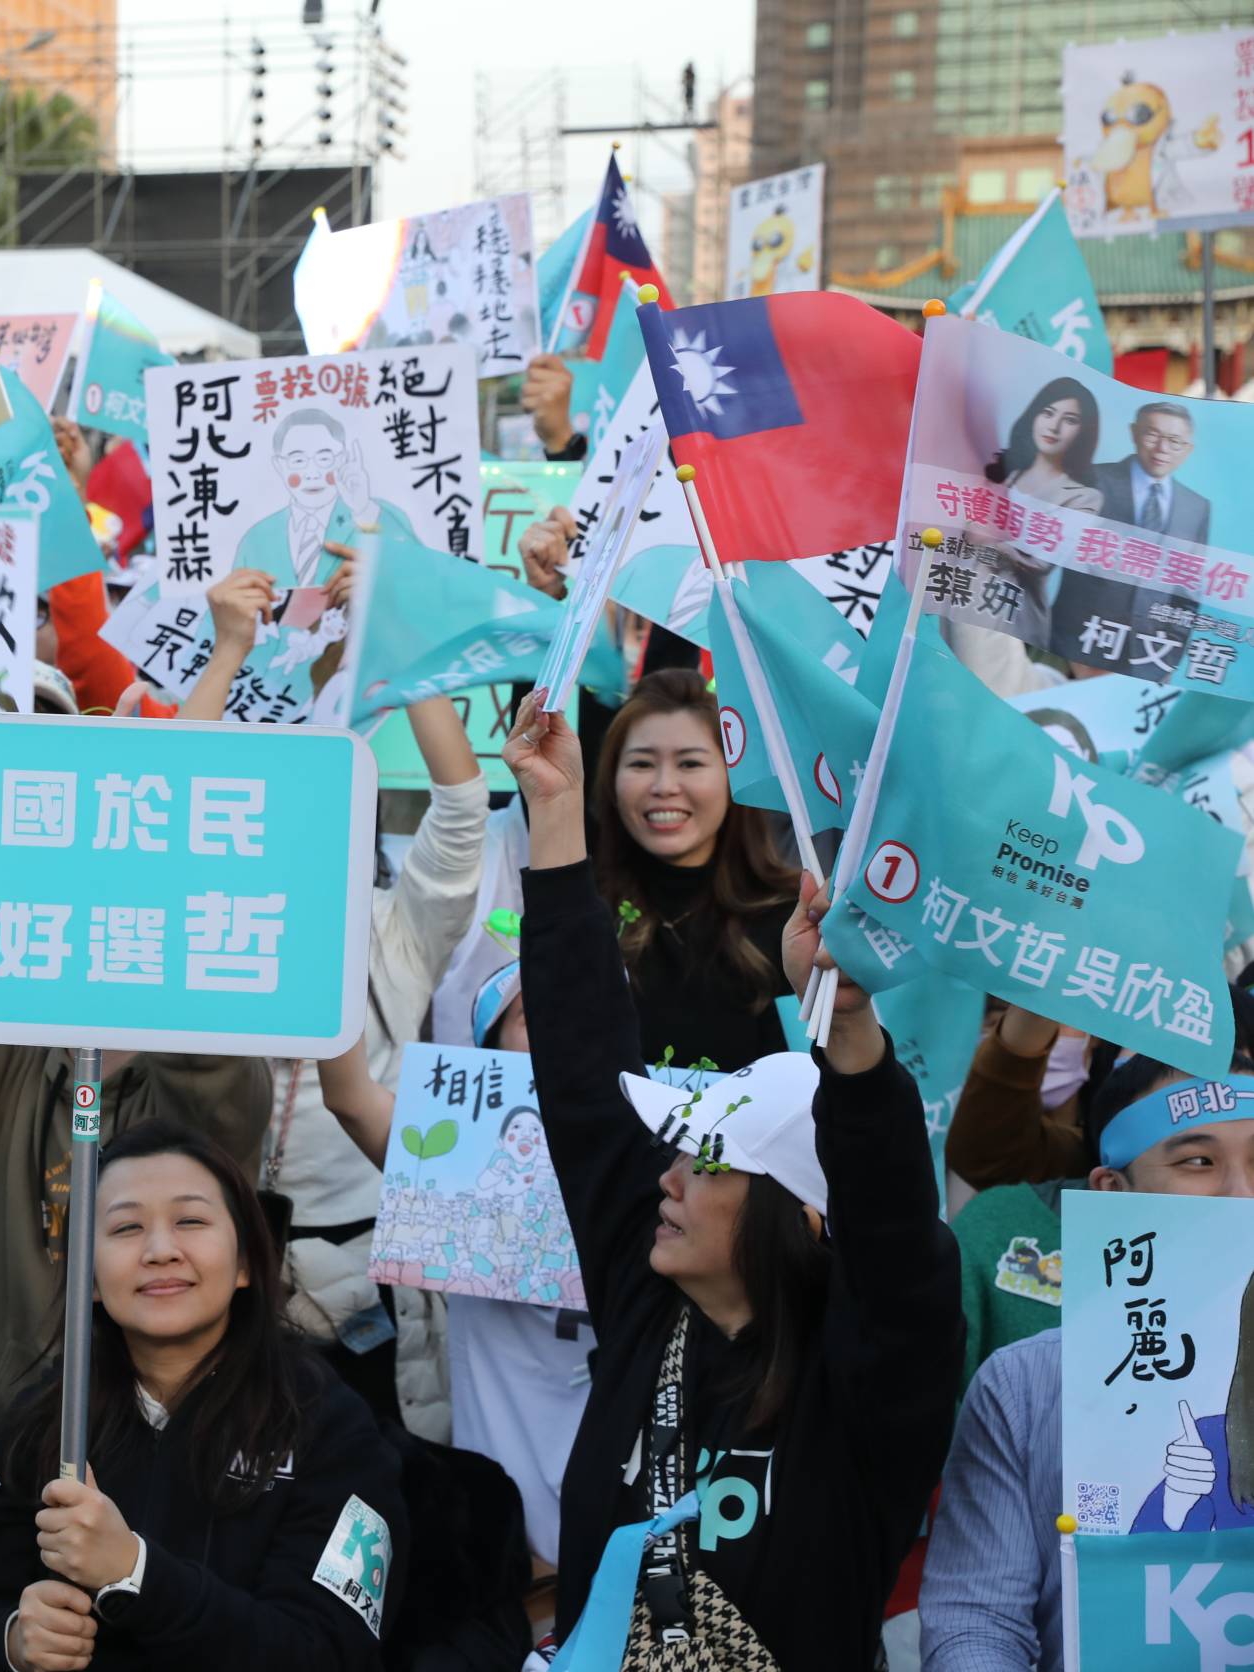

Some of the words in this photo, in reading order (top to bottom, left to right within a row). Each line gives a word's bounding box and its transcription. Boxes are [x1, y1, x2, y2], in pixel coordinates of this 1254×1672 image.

[105, 390, 146, 426] 柯文
[1074, 527, 1250, 602] 我需要你
[1078, 615, 1239, 686] 柯文哲
[1005, 818, 1059, 857] Keep
[996, 842, 1090, 893] Promise
[920, 876, 1068, 989] 柯文哲
[1060, 945, 1216, 1046] 吳欣盈
[74, 1113, 101, 1132] 柯文
